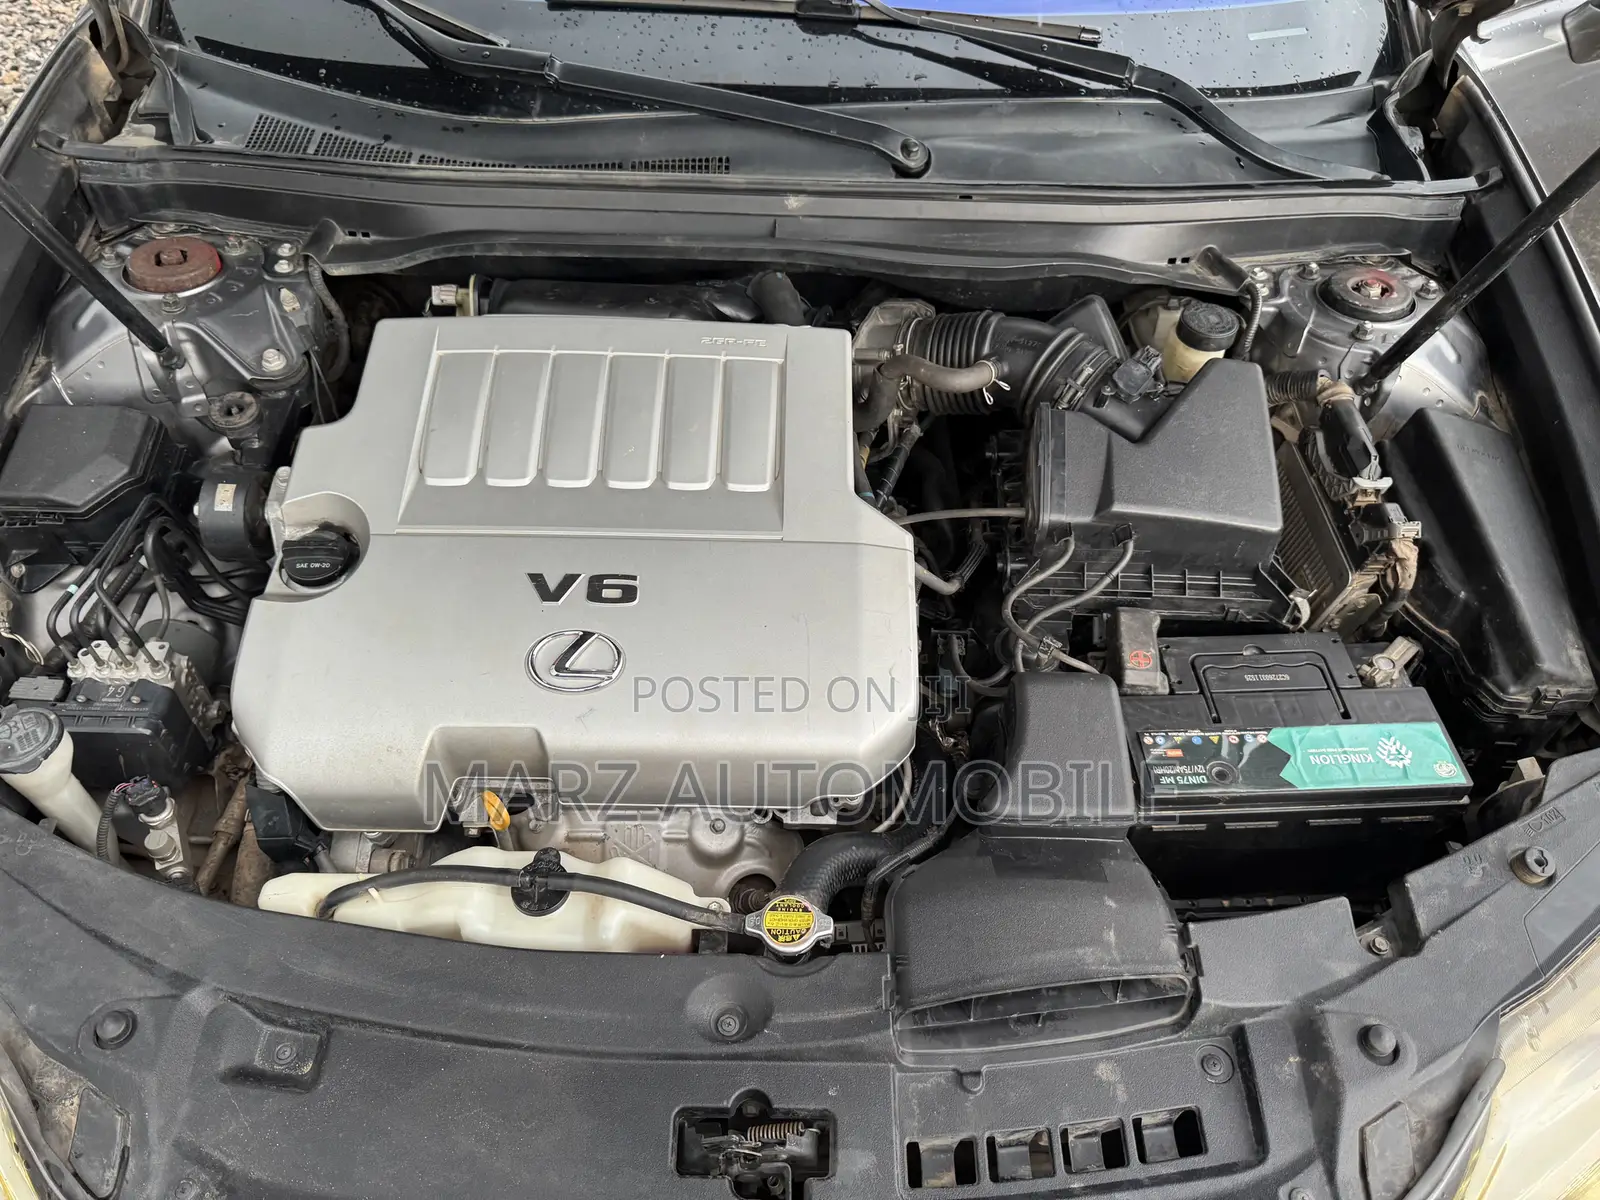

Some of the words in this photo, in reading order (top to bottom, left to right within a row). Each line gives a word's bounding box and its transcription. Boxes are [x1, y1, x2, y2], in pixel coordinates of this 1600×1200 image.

[525, 572, 640, 607] V6
[1309, 753, 1374, 765] KINGLION
[1177, 775, 1208, 784] DIN75
